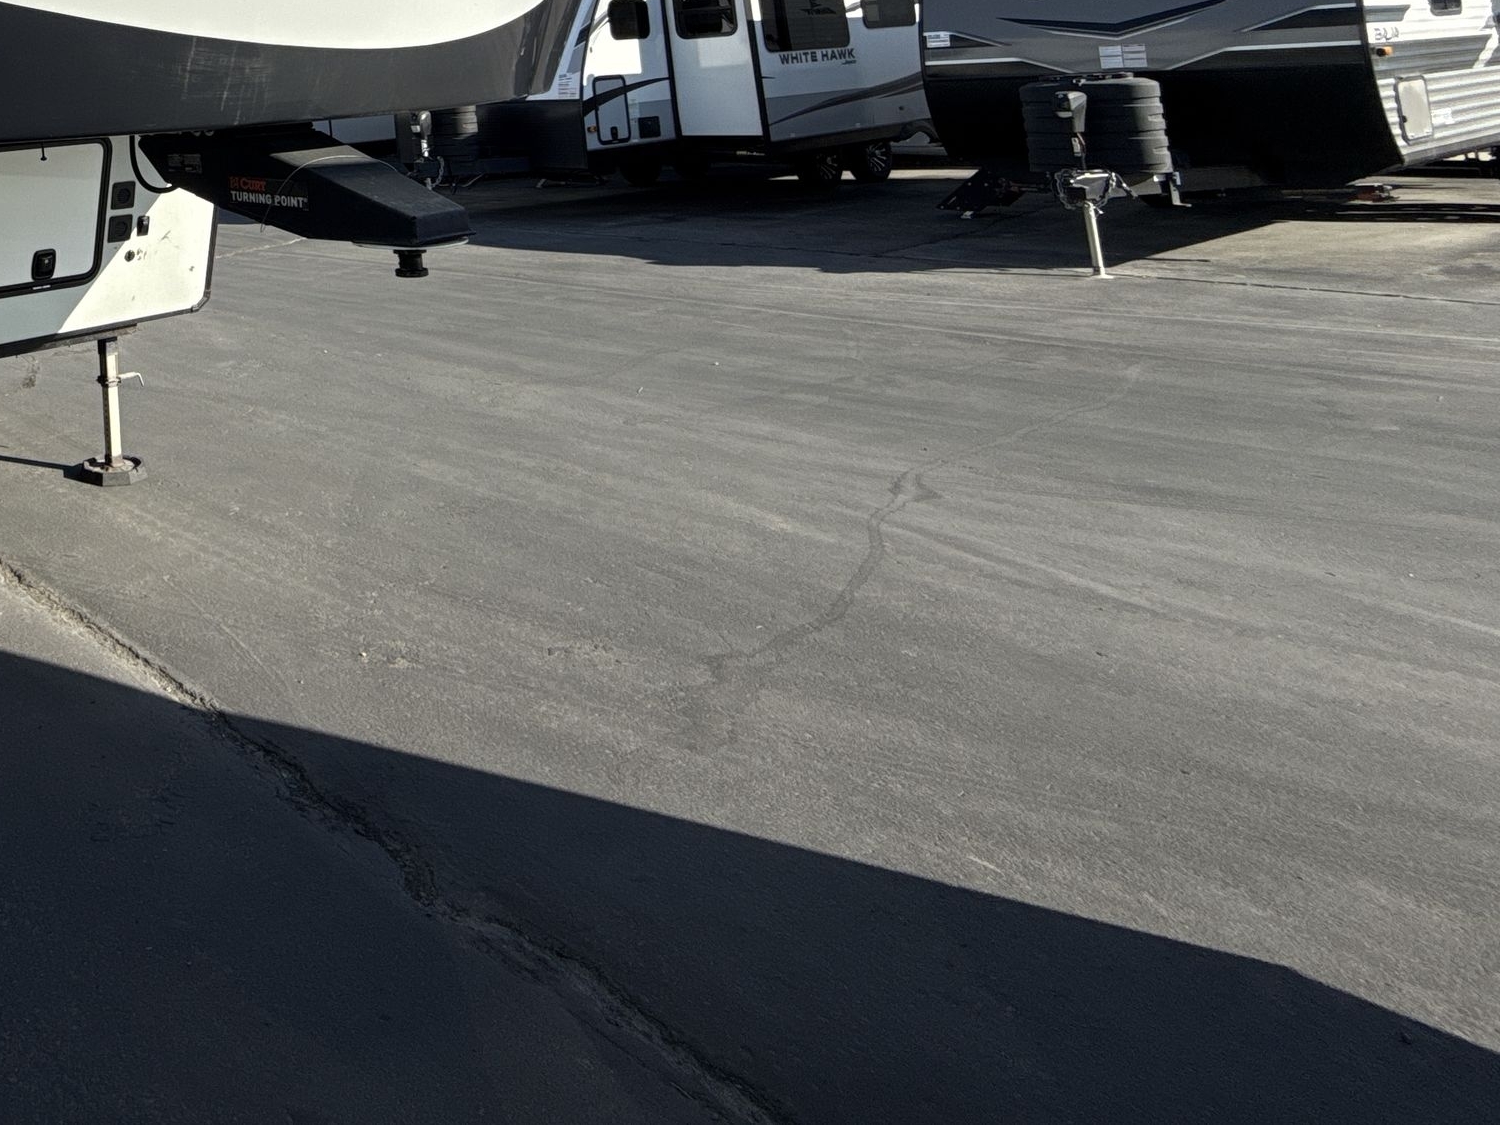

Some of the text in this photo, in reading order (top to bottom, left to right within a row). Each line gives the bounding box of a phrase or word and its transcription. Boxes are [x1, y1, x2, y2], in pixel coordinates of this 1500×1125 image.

[778, 47, 856, 65] WHITE HAWK
[230, 190, 305, 209] TURNING POINT
